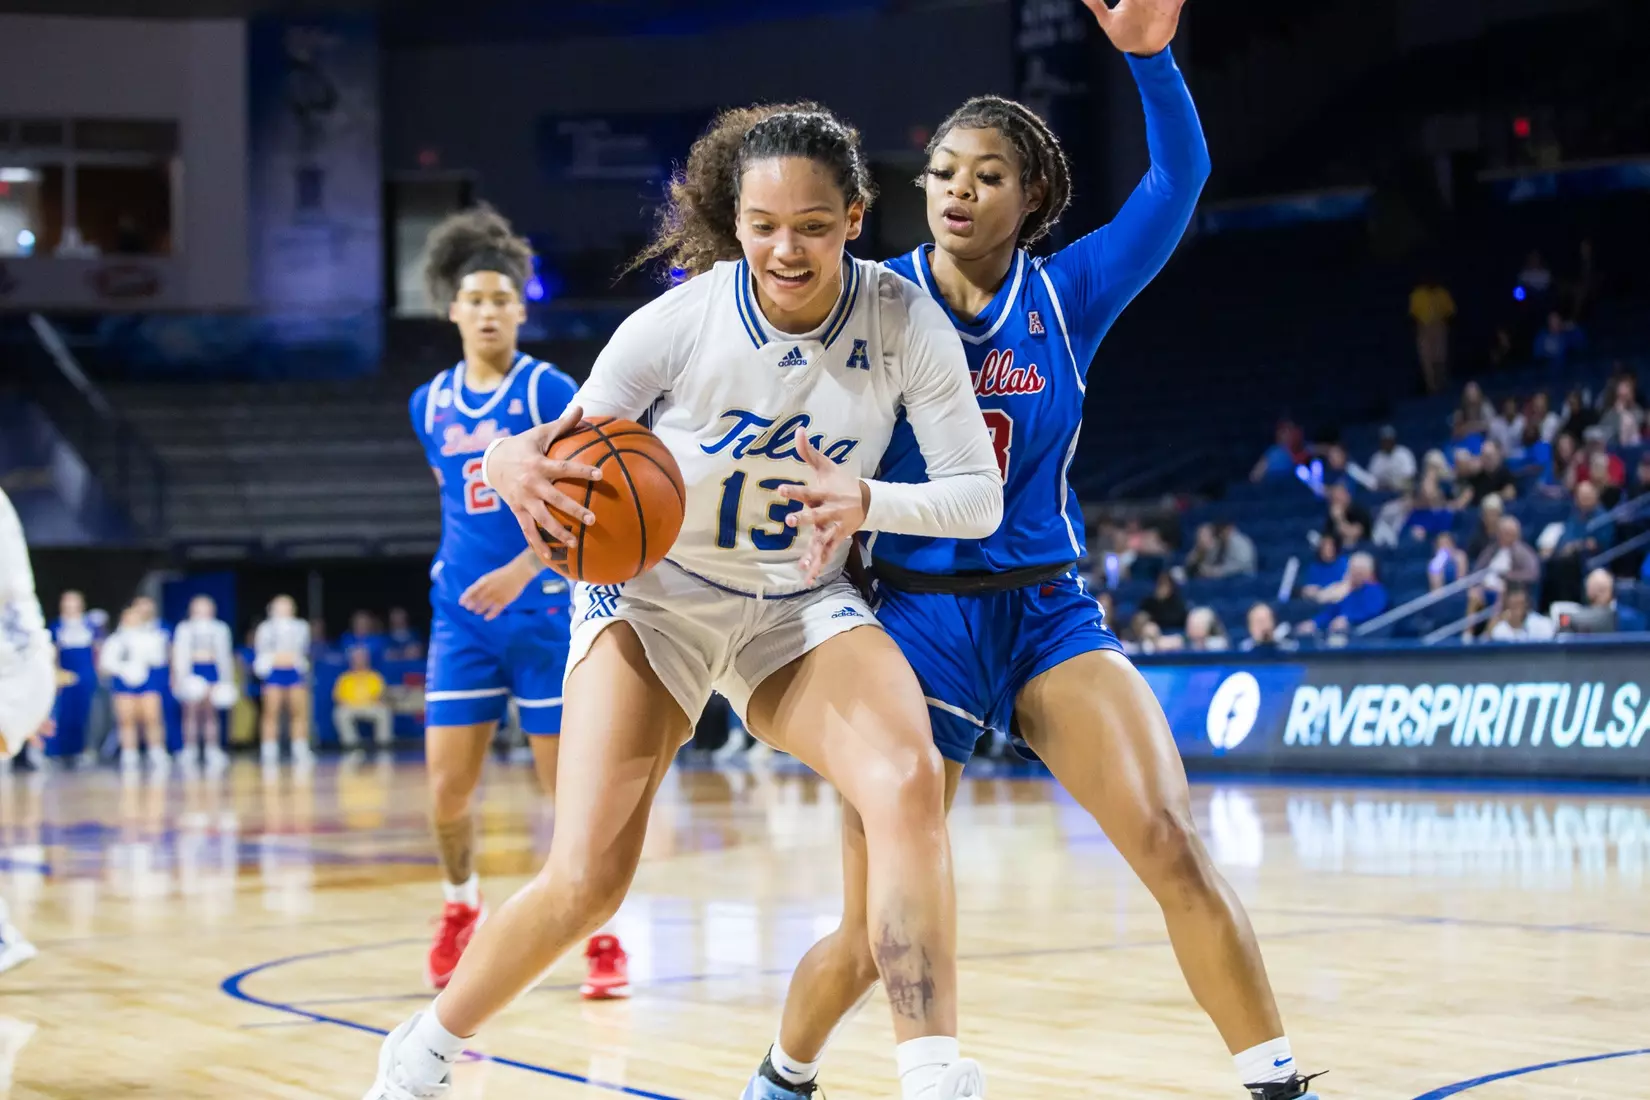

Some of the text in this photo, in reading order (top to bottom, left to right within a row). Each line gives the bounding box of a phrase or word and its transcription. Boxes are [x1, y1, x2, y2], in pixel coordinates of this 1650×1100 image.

[778, 359, 807, 367] adidas
[846, 338, 870, 371] A
[970, 348, 1046, 397] llas
[715, 468, 808, 551] 13
